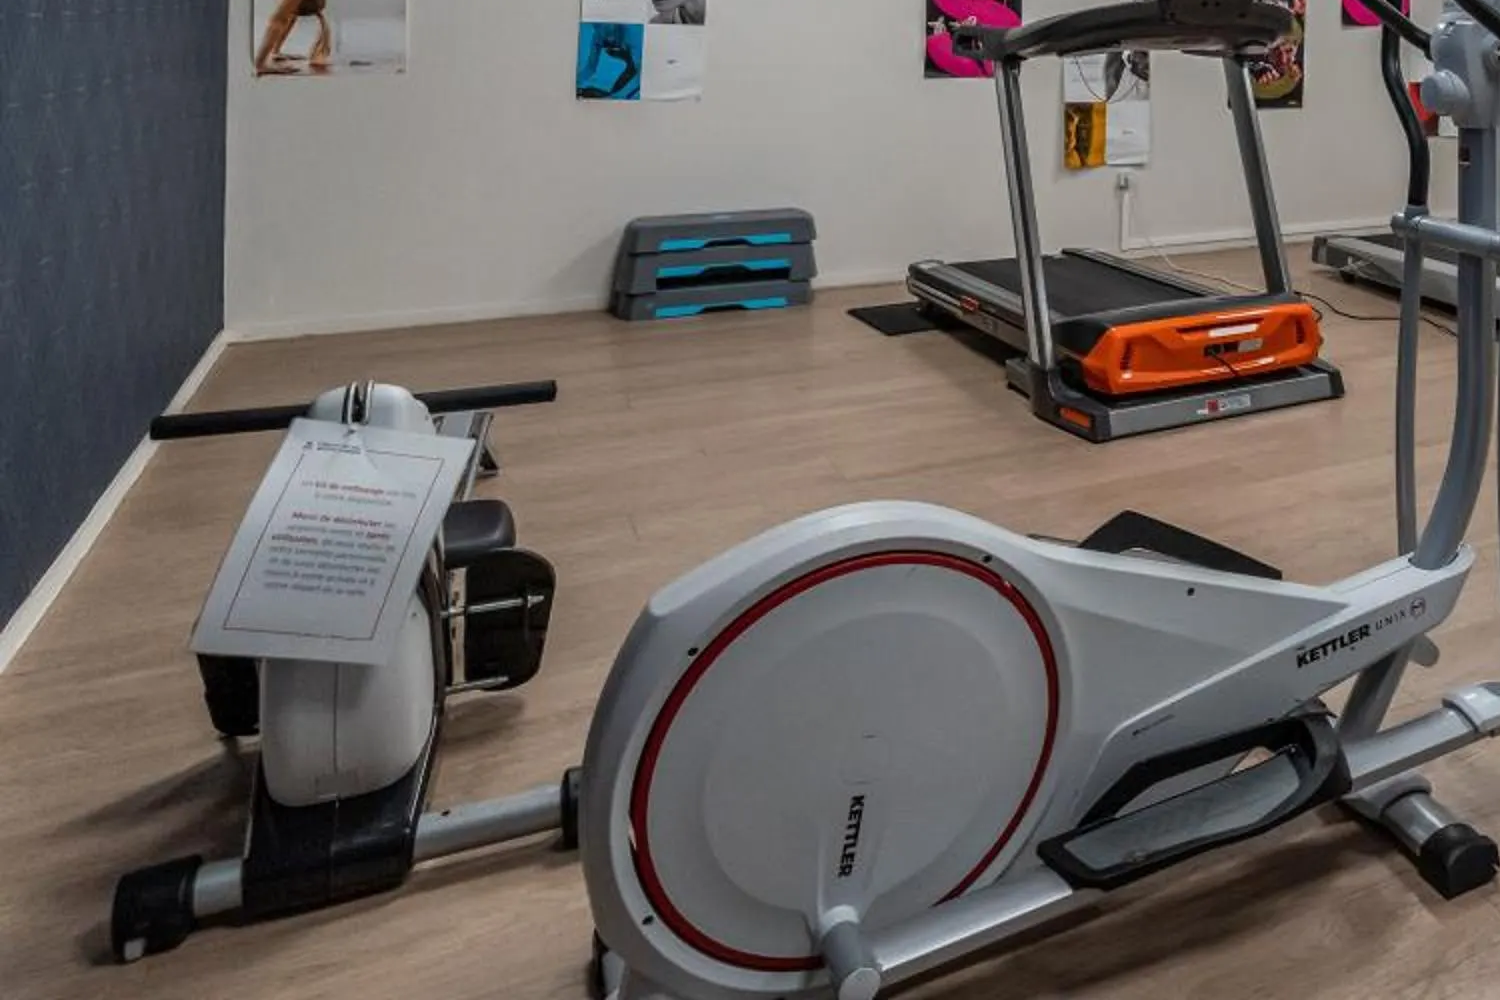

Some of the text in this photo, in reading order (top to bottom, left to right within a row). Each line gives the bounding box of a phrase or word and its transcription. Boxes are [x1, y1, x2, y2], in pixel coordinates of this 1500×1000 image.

[1296, 625, 1371, 669] KETTLER
[1375, 609, 1406, 631] UNIX
[838, 795, 865, 878] KETTLER
